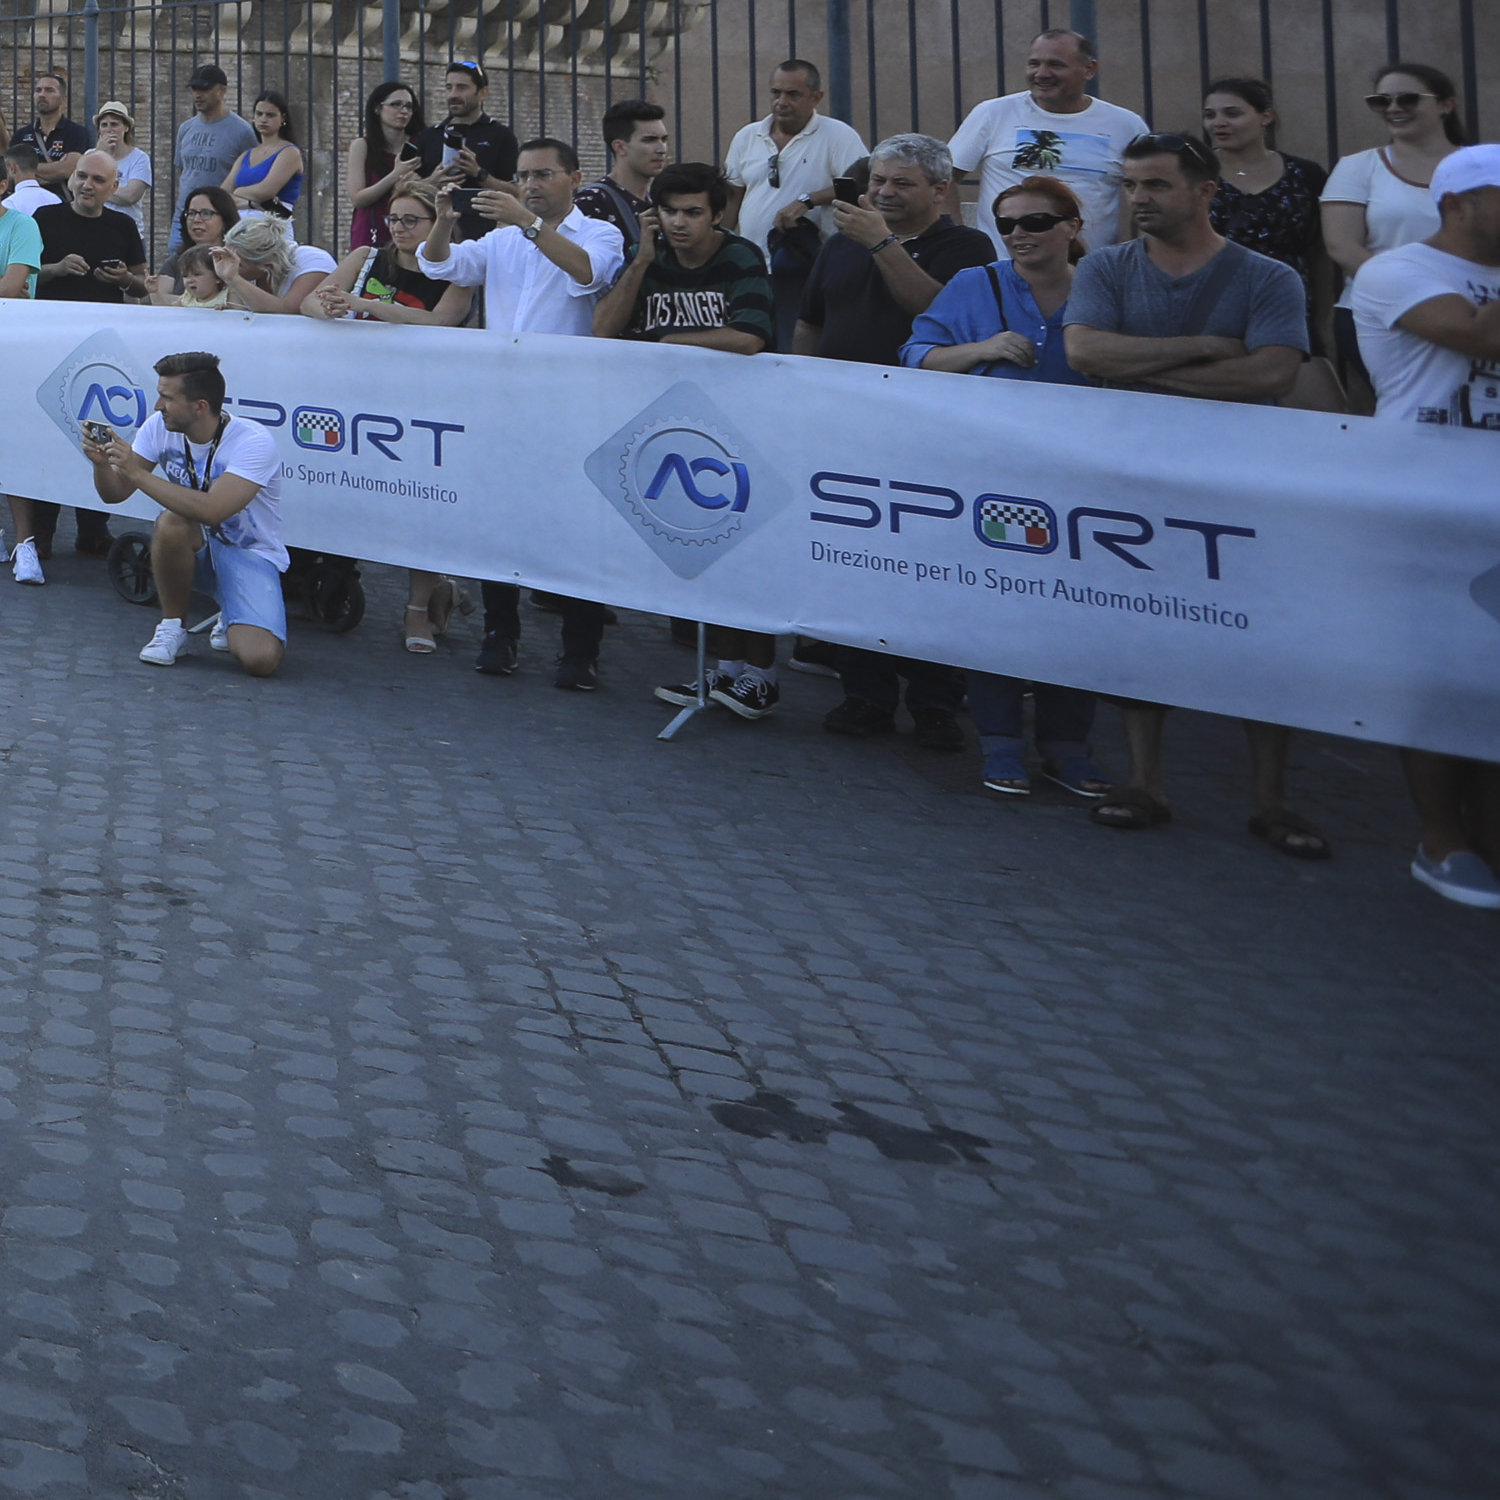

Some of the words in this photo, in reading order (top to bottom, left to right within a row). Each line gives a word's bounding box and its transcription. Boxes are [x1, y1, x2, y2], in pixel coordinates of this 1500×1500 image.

[645, 292, 671, 331] LOS
[77, 382, 147, 429] ACI
[223, 396, 465, 468] PORT
[281, 461, 294, 479] lo
[297, 464, 337, 487] Sport
[339, 469, 458, 504] Automobilistico
[643, 452, 752, 513] ACI
[809, 470, 1256, 581] SPORT
[810, 540, 909, 577] Direzione
[914, 561, 951, 585] per
[957, 559, 977, 586] lo
[984, 567, 1048, 599] Sport
[1051, 576, 1250, 630] Automobilistico
